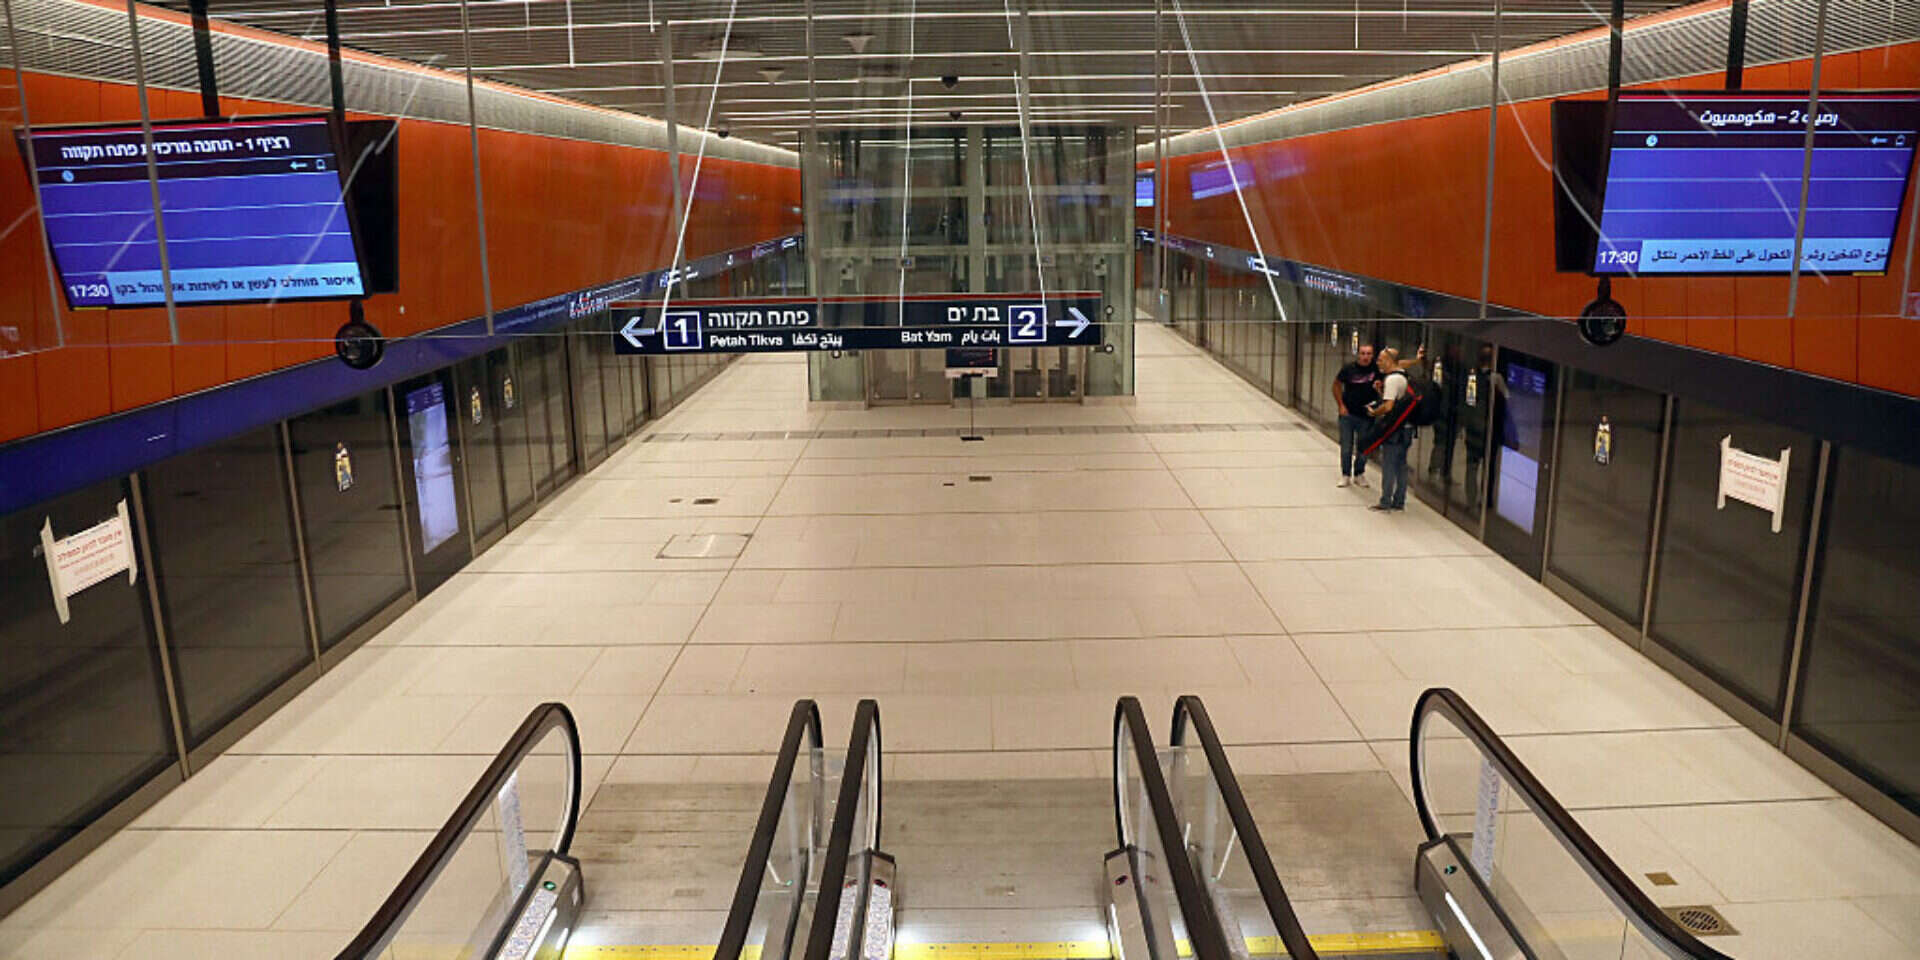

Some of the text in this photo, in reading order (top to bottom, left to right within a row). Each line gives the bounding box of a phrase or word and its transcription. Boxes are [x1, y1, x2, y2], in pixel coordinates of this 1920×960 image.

[1788, 110, 1800, 124] 2
[106, 144, 138, 158] פתח
[194, 139, 234, 153] תחנה
[246, 138, 254, 151] 1
[256, 136, 290, 152] רציף
[61, 144, 104, 162] תקווה
[1599, 250, 1638, 264] 17:30
[1736, 248, 1756, 264] على
[1800, 248, 1827, 262] وشر
[232, 280, 245, 290] או
[320, 276, 354, 286] איסור
[70, 284, 110, 300] 17:30
[708, 310, 810, 331] פתח תקווה
[948, 306, 1000, 322] בת ים
[1017, 310, 1037, 337] 2
[674, 318, 688, 344] 1
[900, 330, 952, 342] Bat Yam
[960, 329, 1000, 346] بات يام
[710, 334, 783, 347] Petah Tikva
